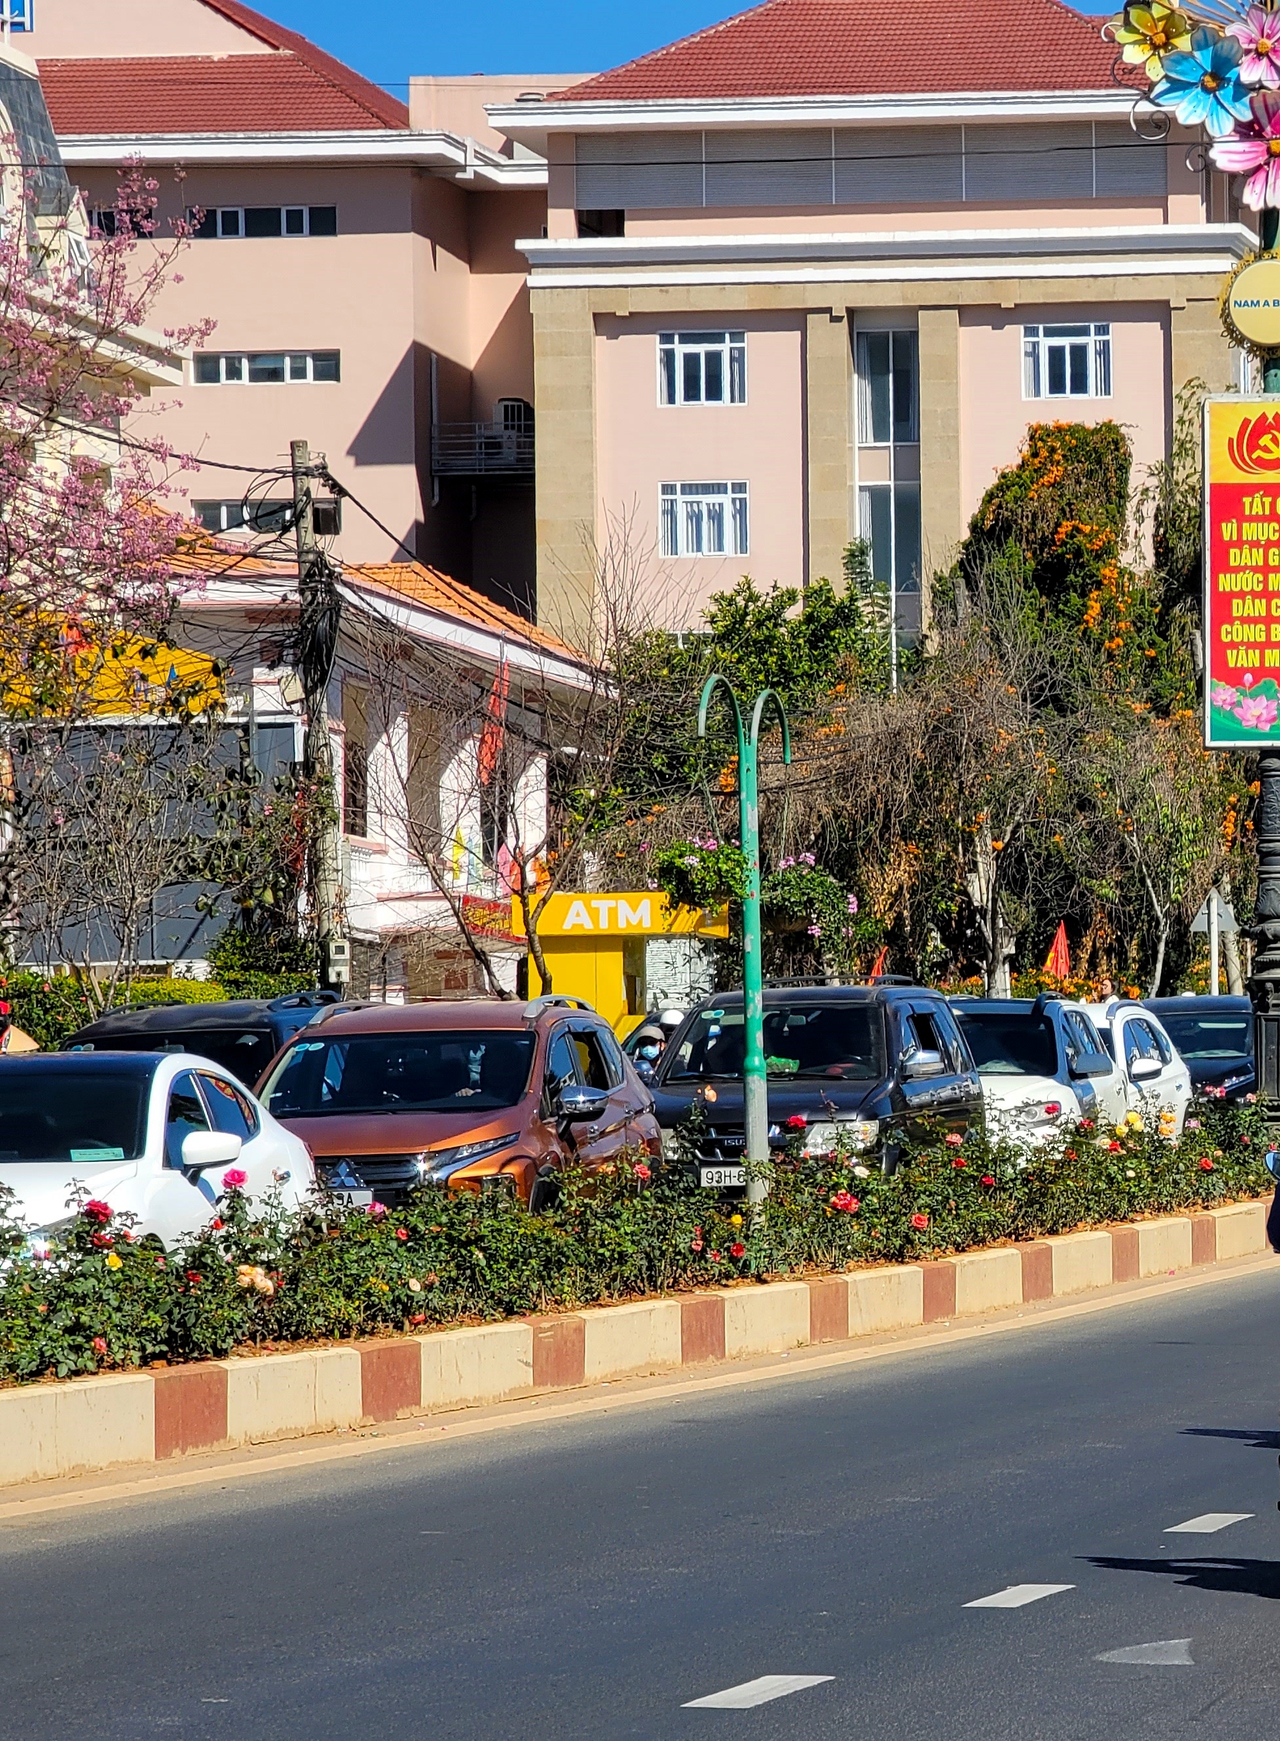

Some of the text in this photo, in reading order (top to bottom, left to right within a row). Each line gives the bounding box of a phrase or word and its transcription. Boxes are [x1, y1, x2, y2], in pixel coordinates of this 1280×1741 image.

[1234, 299, 1260, 308] NAM
[1262, 299, 1270, 307] A
[1243, 491, 1272, 515] TẤT
[1221, 519, 1238, 541] VÌ
[1242, 522, 1279, 544] MỤC
[1230, 545, 1264, 566] DÂN
[1218, 570, 1264, 592] NƯỚC
[1232, 596, 1266, 616] DÂN
[1221, 621, 1266, 642] CÔNG
[1226, 645, 1260, 667] VĂN
[562, 899, 651, 929] ATM
[706, 1170, 746, 1184] 93H-6
